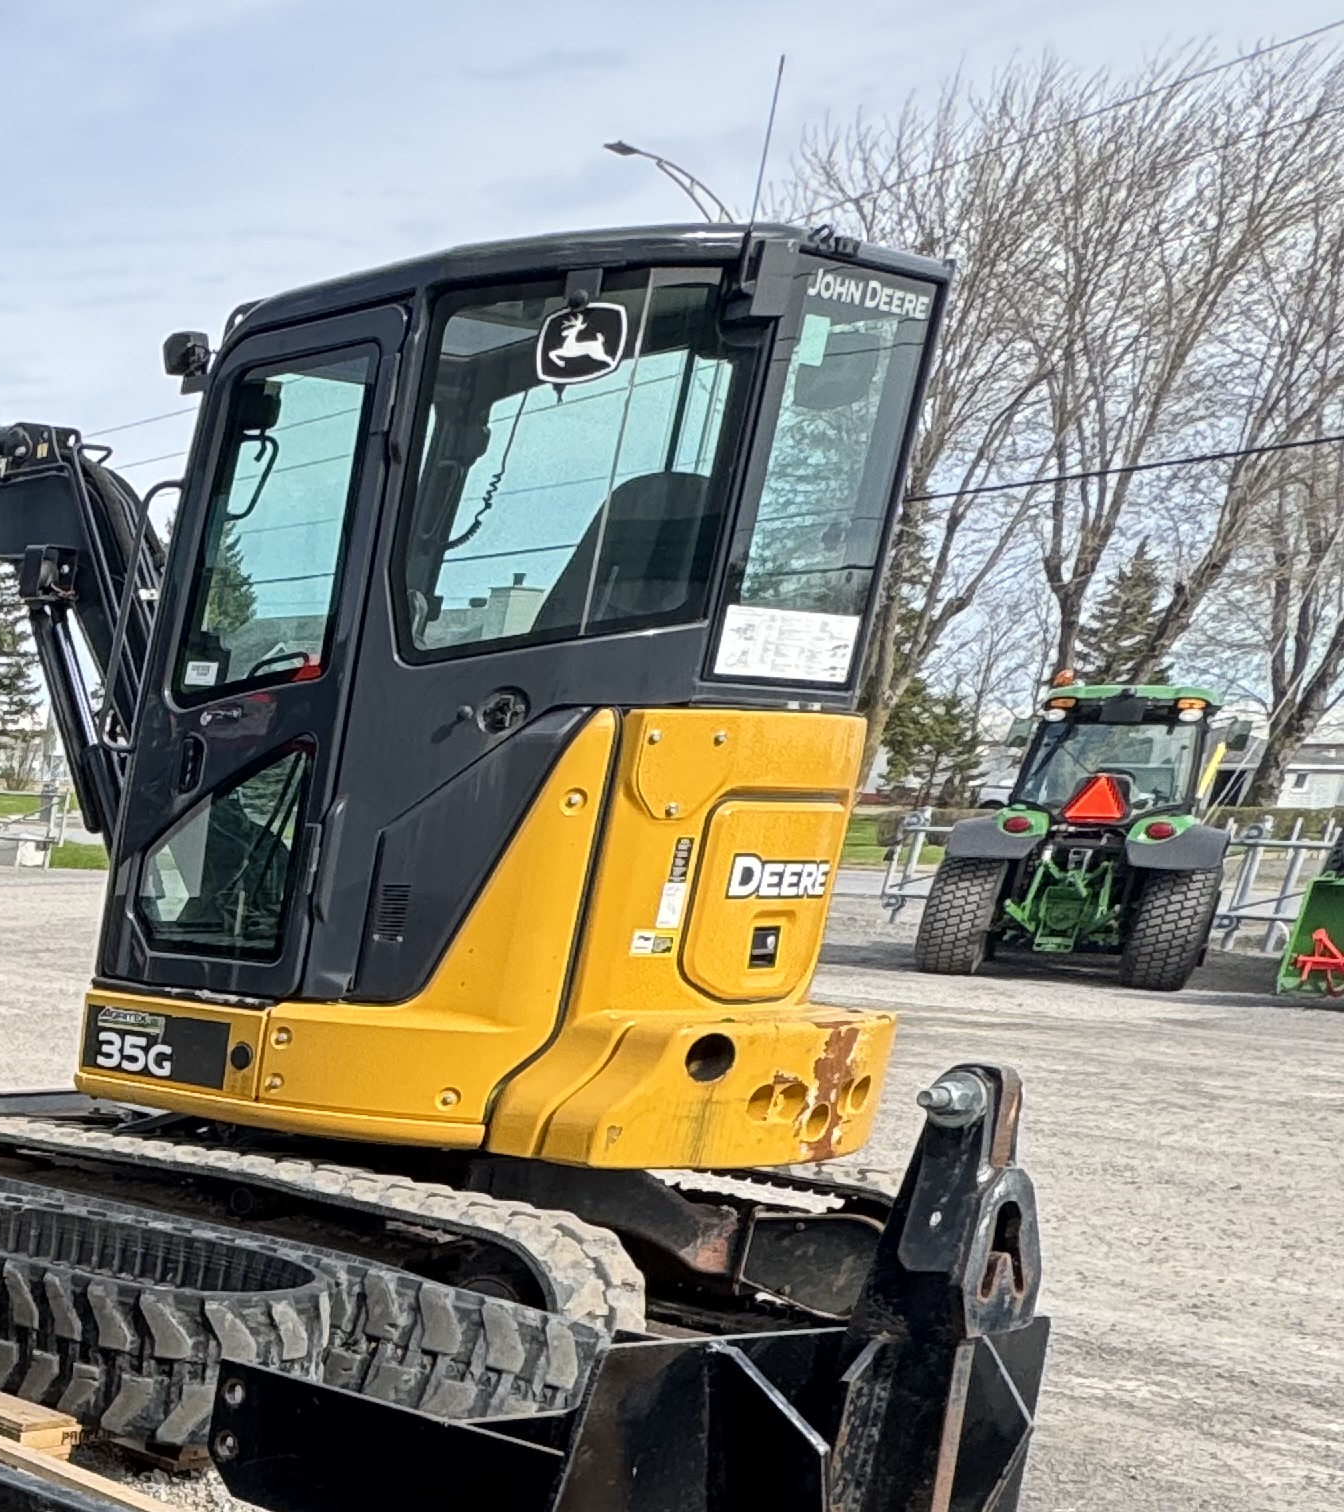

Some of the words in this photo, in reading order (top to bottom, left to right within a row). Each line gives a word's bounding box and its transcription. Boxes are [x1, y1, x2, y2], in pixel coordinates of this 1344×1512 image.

[807, 268, 864, 305] JOHN
[864, 280, 930, 319] DEERE
[725, 853, 831, 899] DEERE
[96, 1031, 172, 1077] 35G
